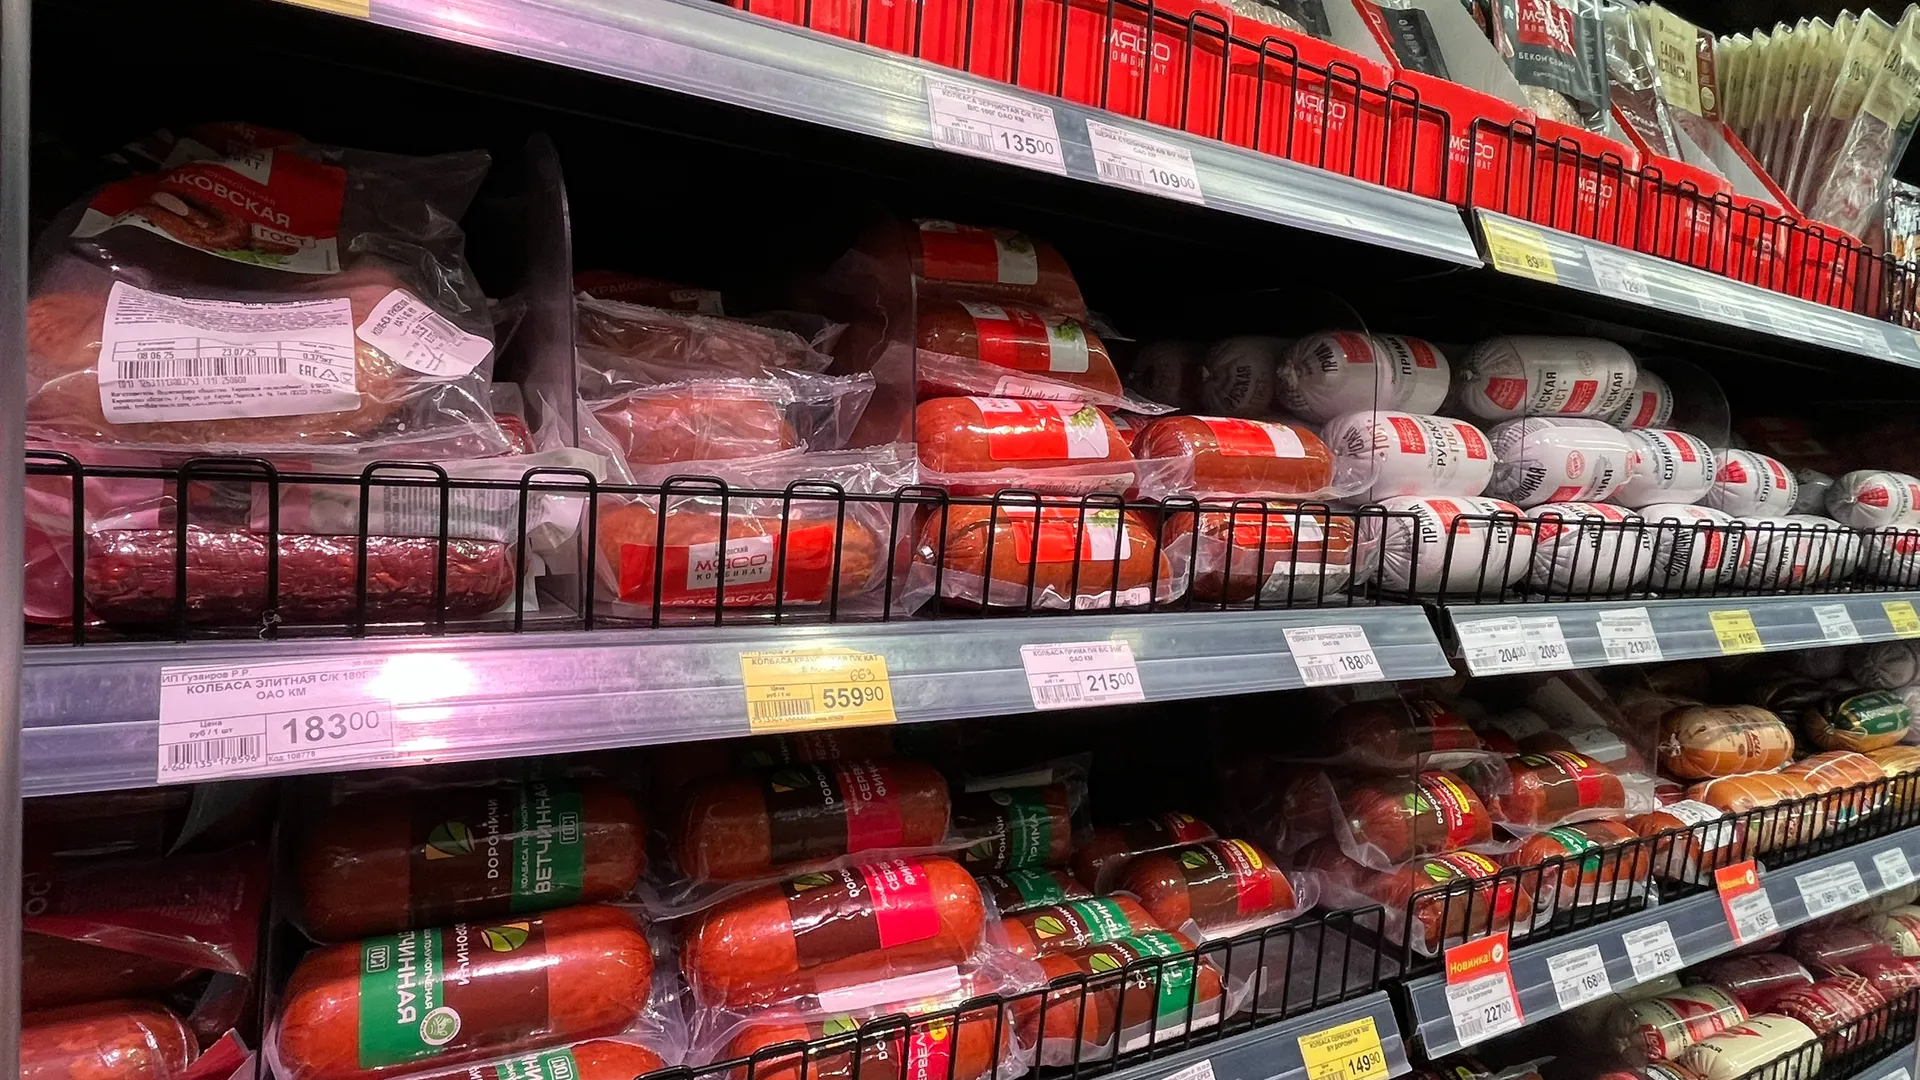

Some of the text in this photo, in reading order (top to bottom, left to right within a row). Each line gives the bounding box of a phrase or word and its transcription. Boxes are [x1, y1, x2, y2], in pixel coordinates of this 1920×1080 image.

[1518, 52, 1547, 62] БЕКОН
[1295, 90, 1346, 120] МЯСО
[260, 227, 308, 247] ГОСТ
[1530, 371, 1557, 415] УССКАЯ
[186, 681, 252, 694] КОЛБАСА
[256, 675, 317, 688] ЭЛИТНАЯ
[320, 673, 339, 683] С/К
[850, 668, 875, 682] 663
[256, 687, 306, 700] ОАО КМ
[189, 729, 205, 739] руб
[200, 720, 223, 728] Цена
[219, 754, 258, 766] 178596
[562, 815, 576, 842] ГОСТ
[370, 948, 386, 968] ГОСТ
[1450, 951, 1491, 975] Новинка!
